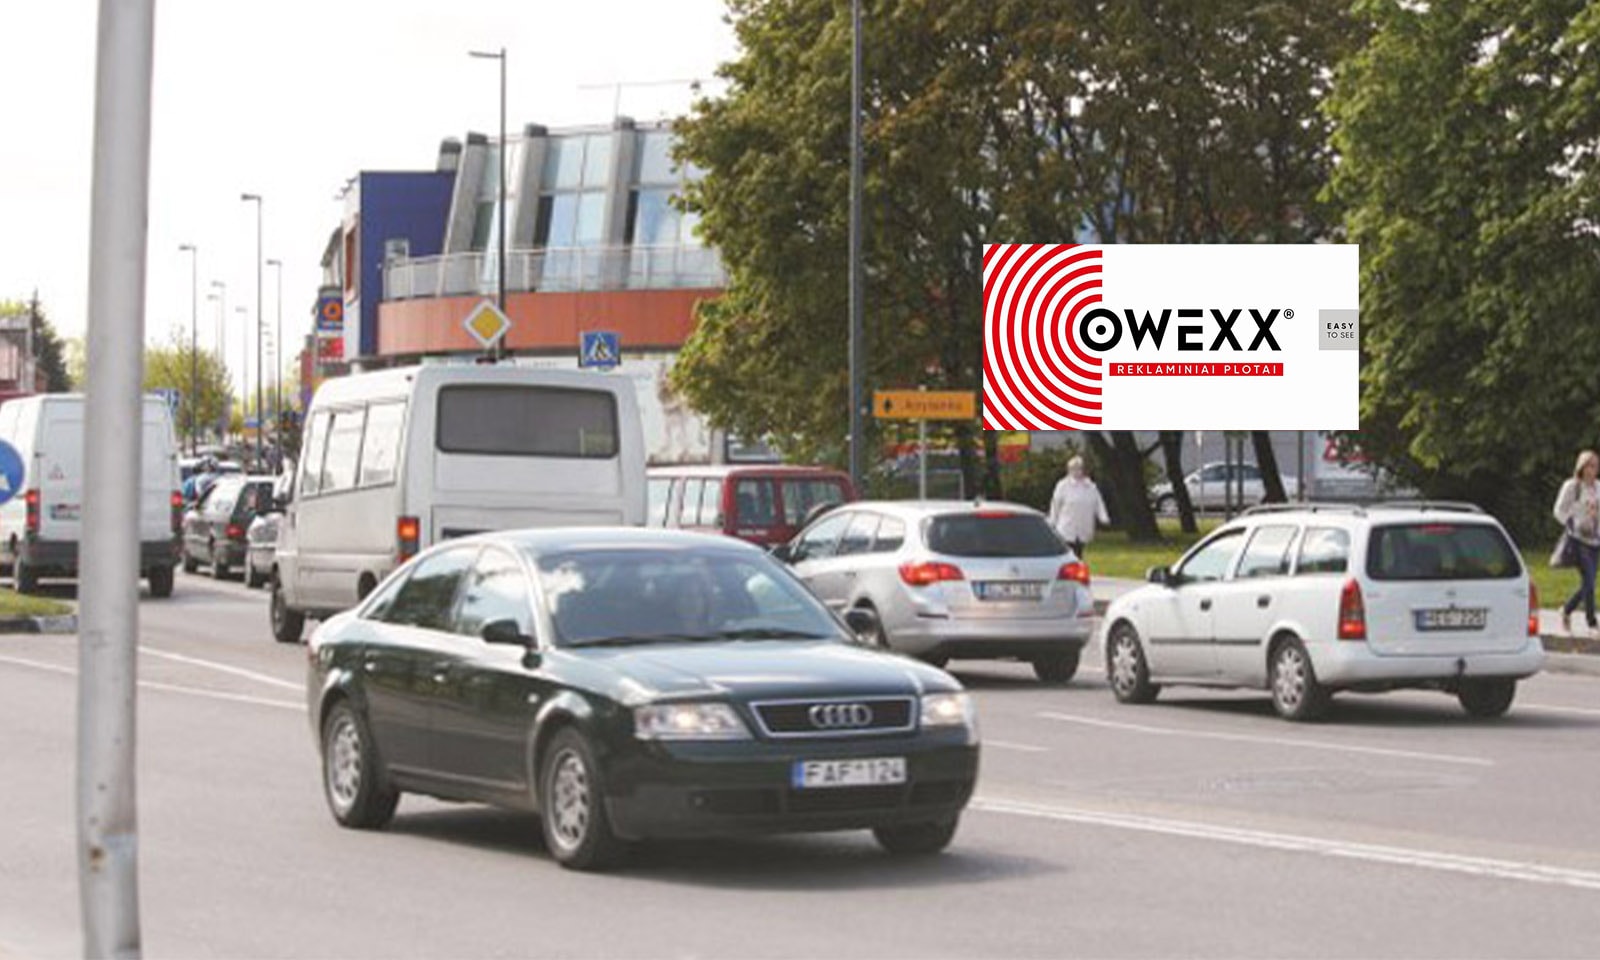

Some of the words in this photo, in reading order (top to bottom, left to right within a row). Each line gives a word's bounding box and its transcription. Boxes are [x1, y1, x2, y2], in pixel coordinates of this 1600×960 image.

[1327, 322, 1354, 330] EASY
[1327, 331, 1338, 339] TO
[1340, 331, 1355, 339] SEE
[1117, 364, 1216, 375] REKLAMINIAI
[1224, 364, 1277, 375] PLOTAI
